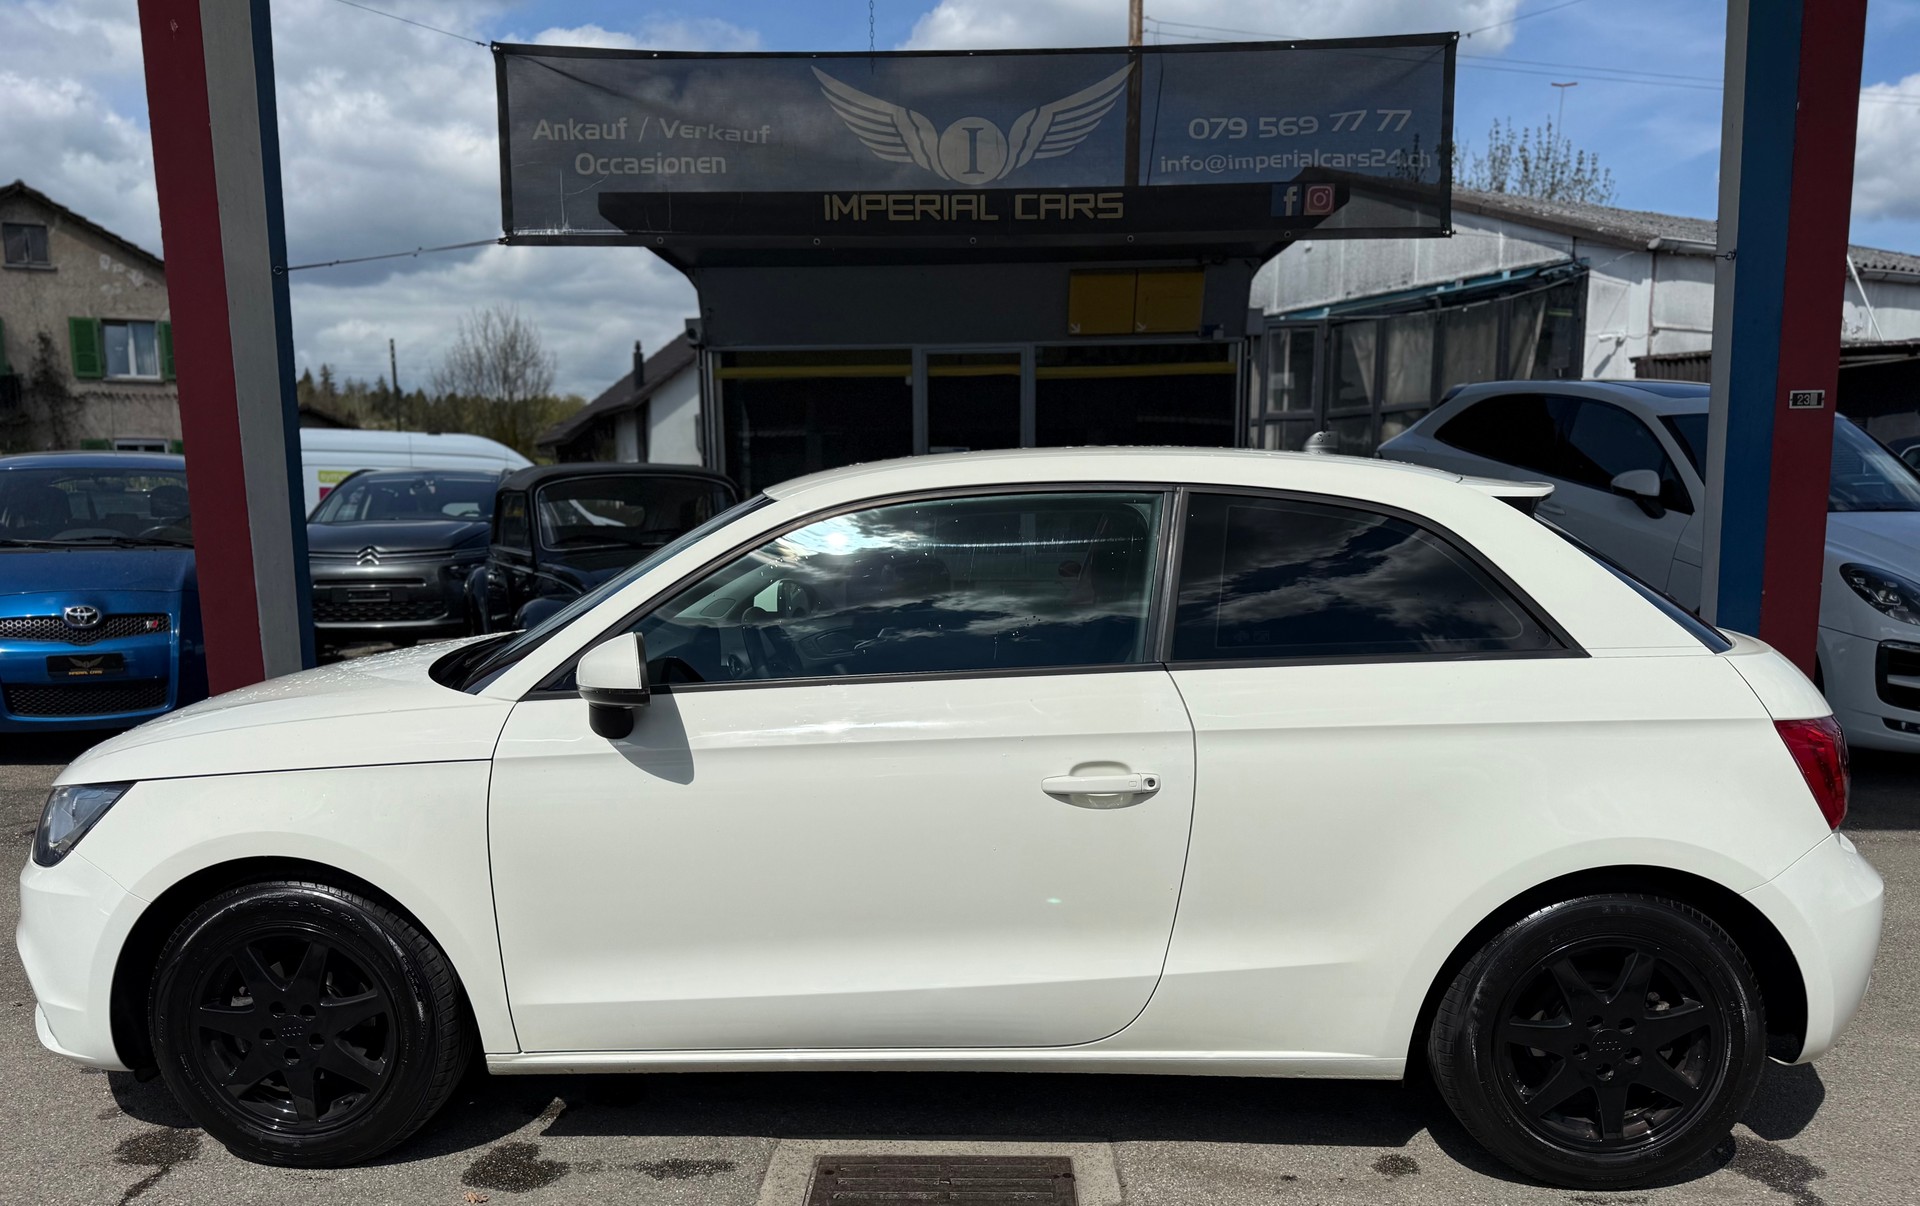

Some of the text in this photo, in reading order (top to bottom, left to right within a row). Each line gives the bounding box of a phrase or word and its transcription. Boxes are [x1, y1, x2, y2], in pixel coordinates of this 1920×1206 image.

[531, 116, 771, 144] Ankauf / Verkauf
[1188, 109, 1412, 140] 079 569 77 77
[575, 152, 726, 176] Occasionen
[1160, 148, 1432, 174] info@imperialcars24.ch
[824, 193, 1124, 221] IMPERIAL CARS
[1797, 394, 1810, 405] 23
